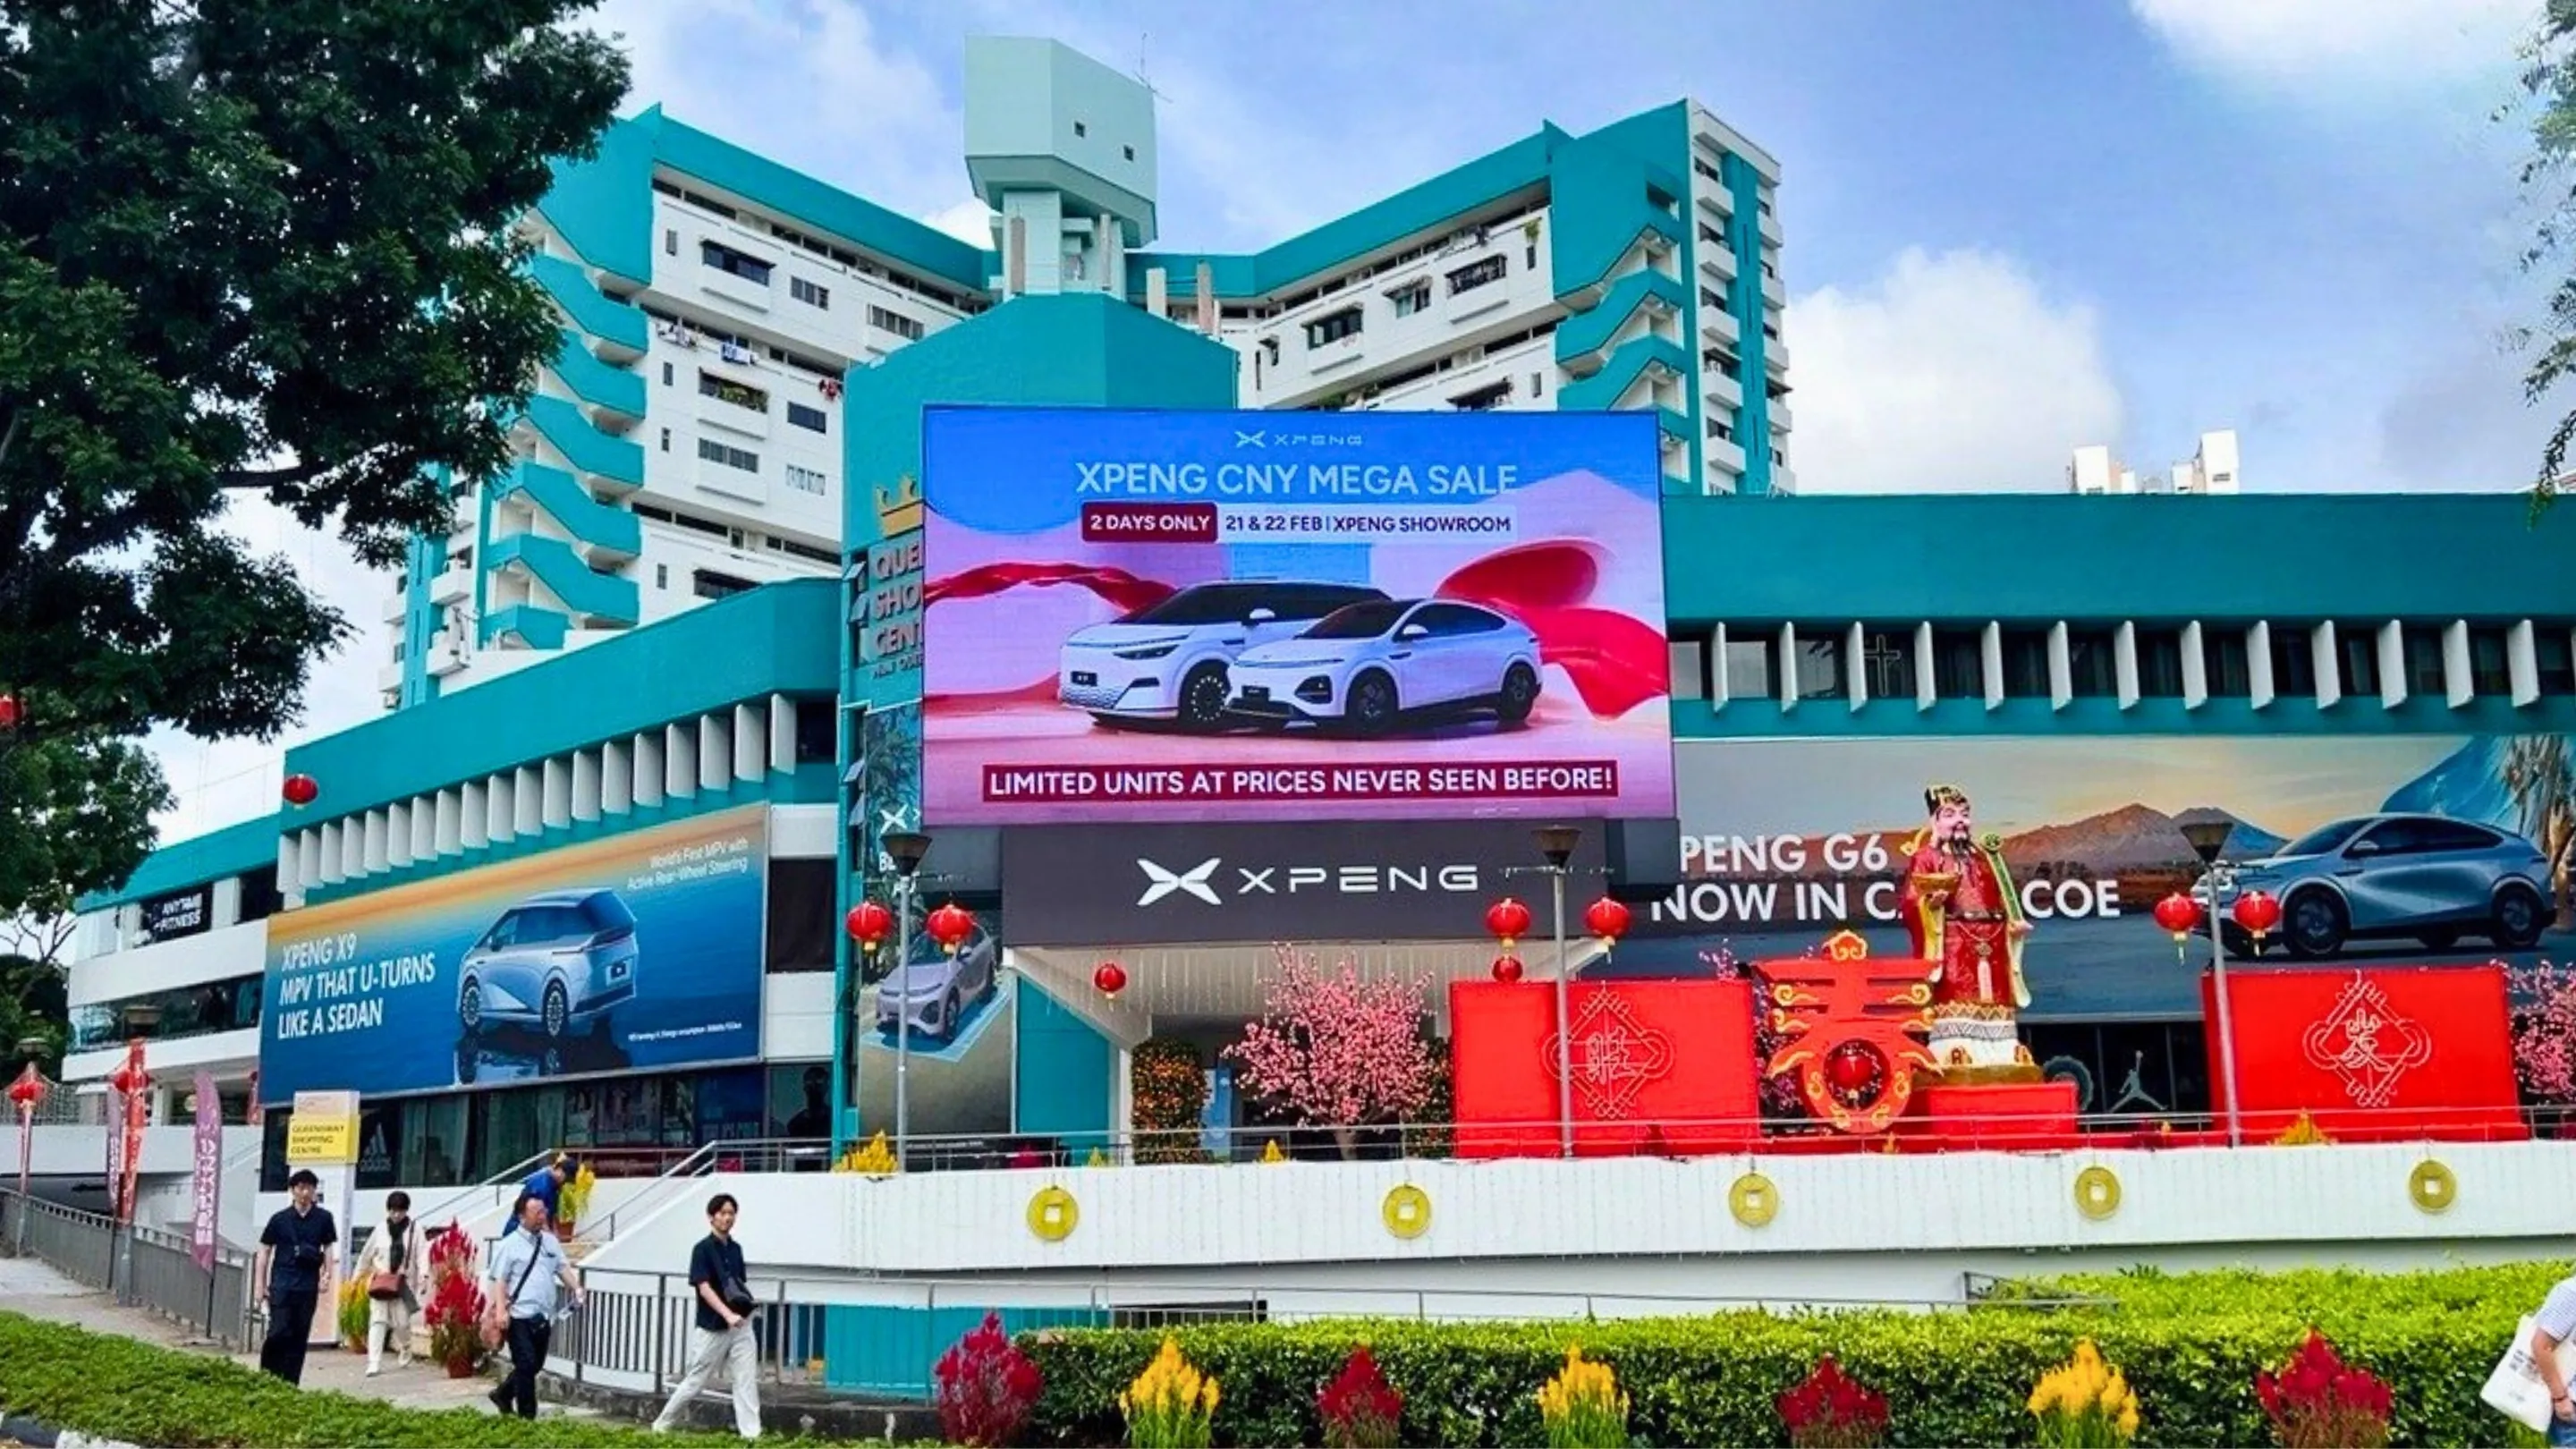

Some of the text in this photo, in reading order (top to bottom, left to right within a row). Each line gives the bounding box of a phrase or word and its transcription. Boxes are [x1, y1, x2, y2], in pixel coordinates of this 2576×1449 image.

[1075, 462, 1518, 495] XPENG CNY MEGA SALE
[1090, 514, 1211, 531] 2 DAYS ONLY
[1225, 515, 1512, 532] 21 & 22 FEB XPENG SHOWROOM
[989, 767, 1613, 795] LIMITED UNITS AT PRICES NEVER SEEN BEFORE!
[1823, 833, 1889, 873] G6
[1238, 865, 1478, 894] XPENG
[1650, 882, 1778, 922] NOW
[1795, 882, 1845, 921] IN
[2021, 878, 2122, 919] COE
[281, 932, 358, 971] XPENG X9
[278, 952, 436, 1006] MPV THAT U-TURNS
[277, 998, 385, 1040] LIKE A SEDAN
